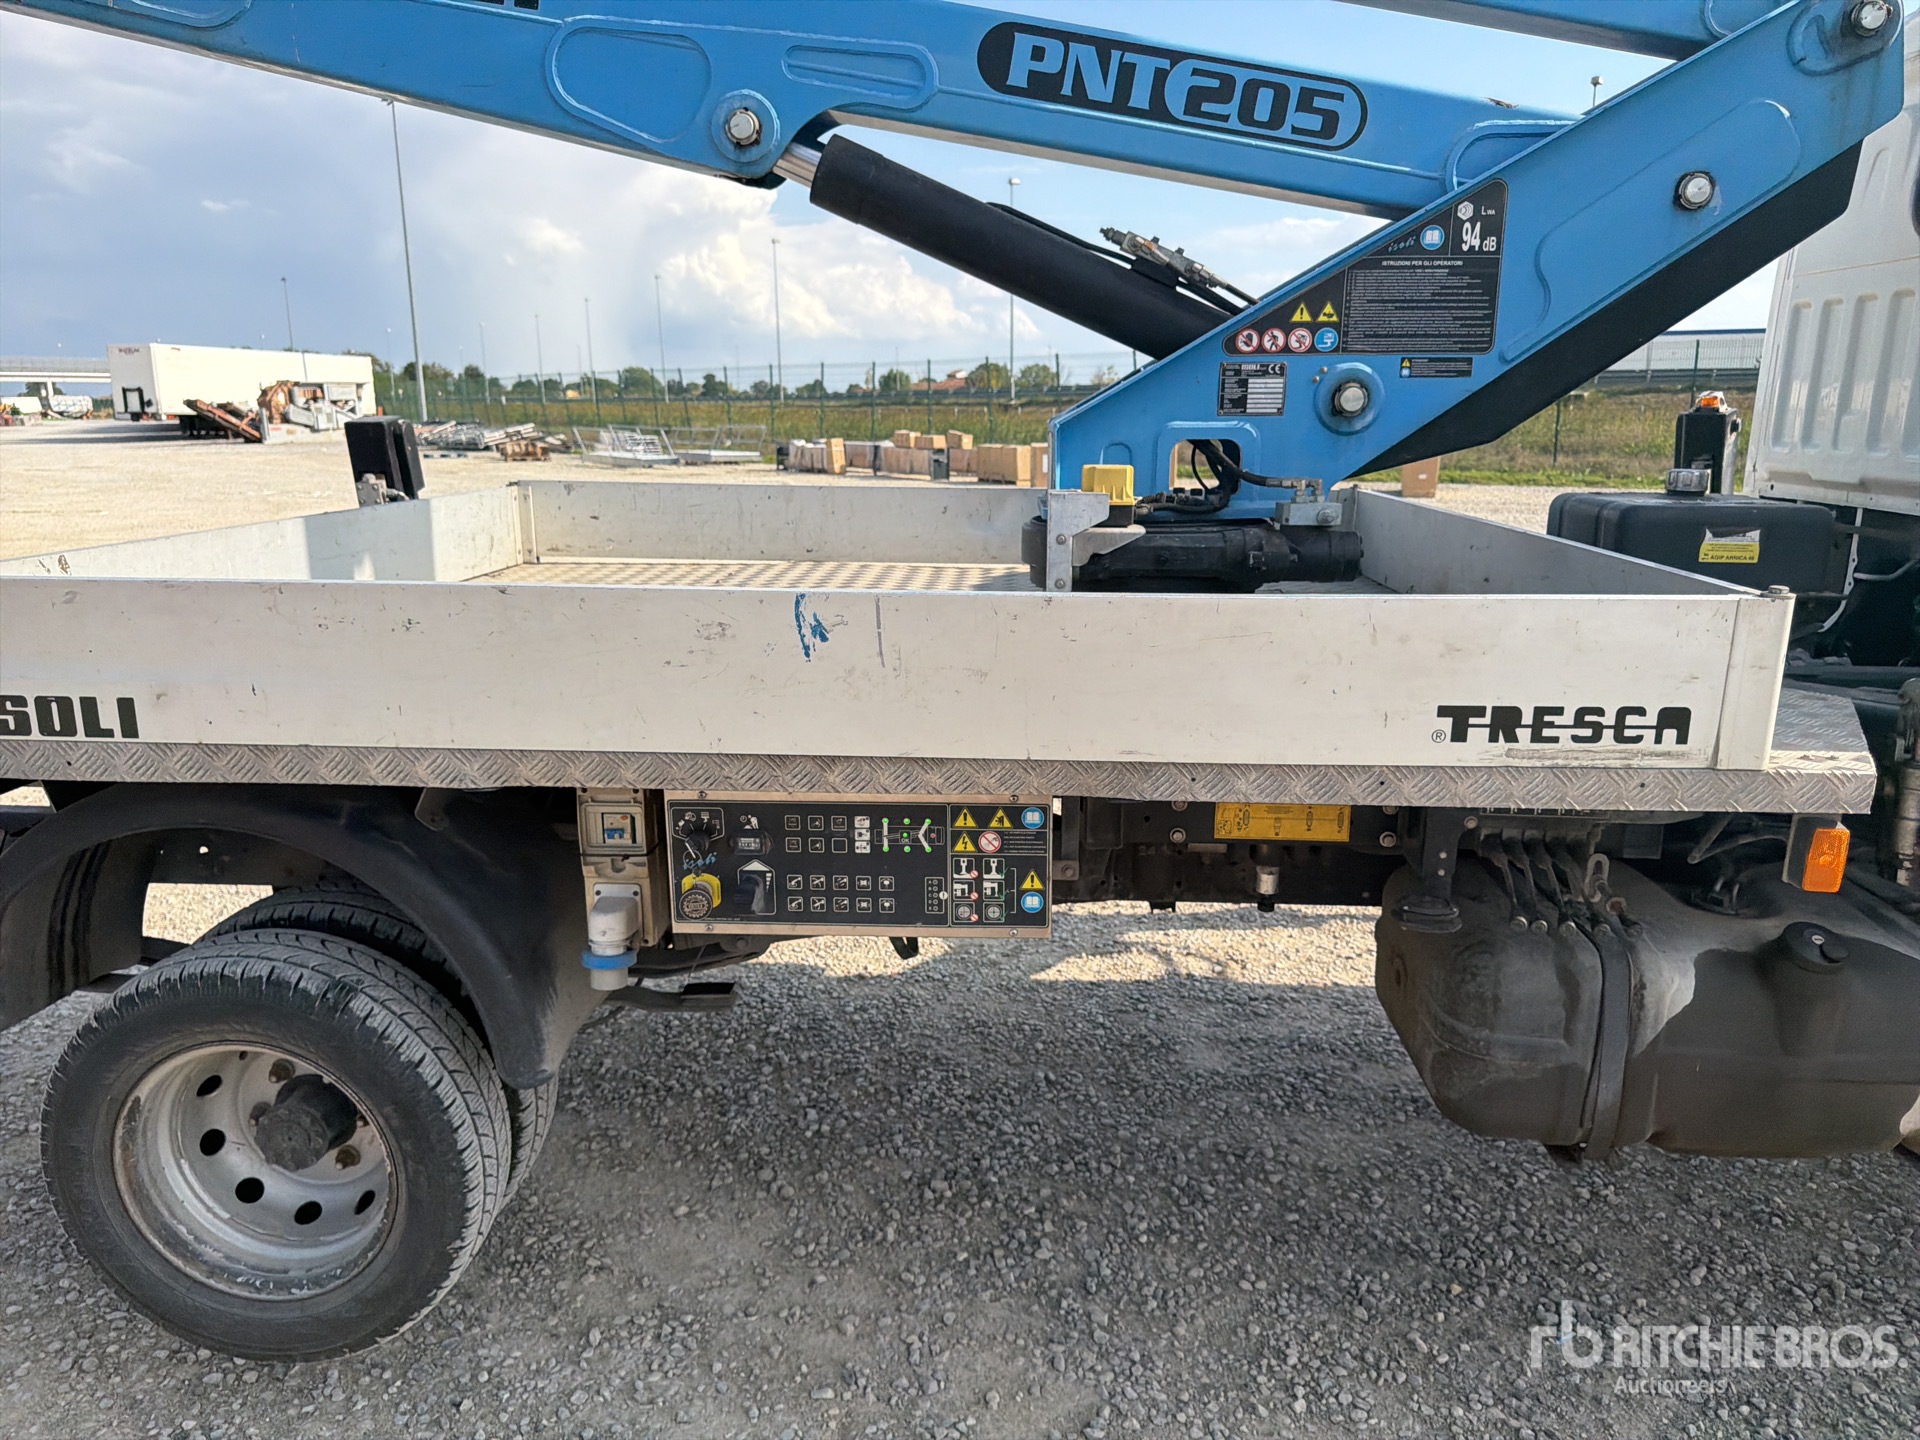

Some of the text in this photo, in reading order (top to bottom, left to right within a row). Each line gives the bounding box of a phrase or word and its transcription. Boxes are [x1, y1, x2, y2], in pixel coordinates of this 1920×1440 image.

[1461, 221, 1497, 252] 94 dB
[1436, 705, 1692, 745] TRESCA
